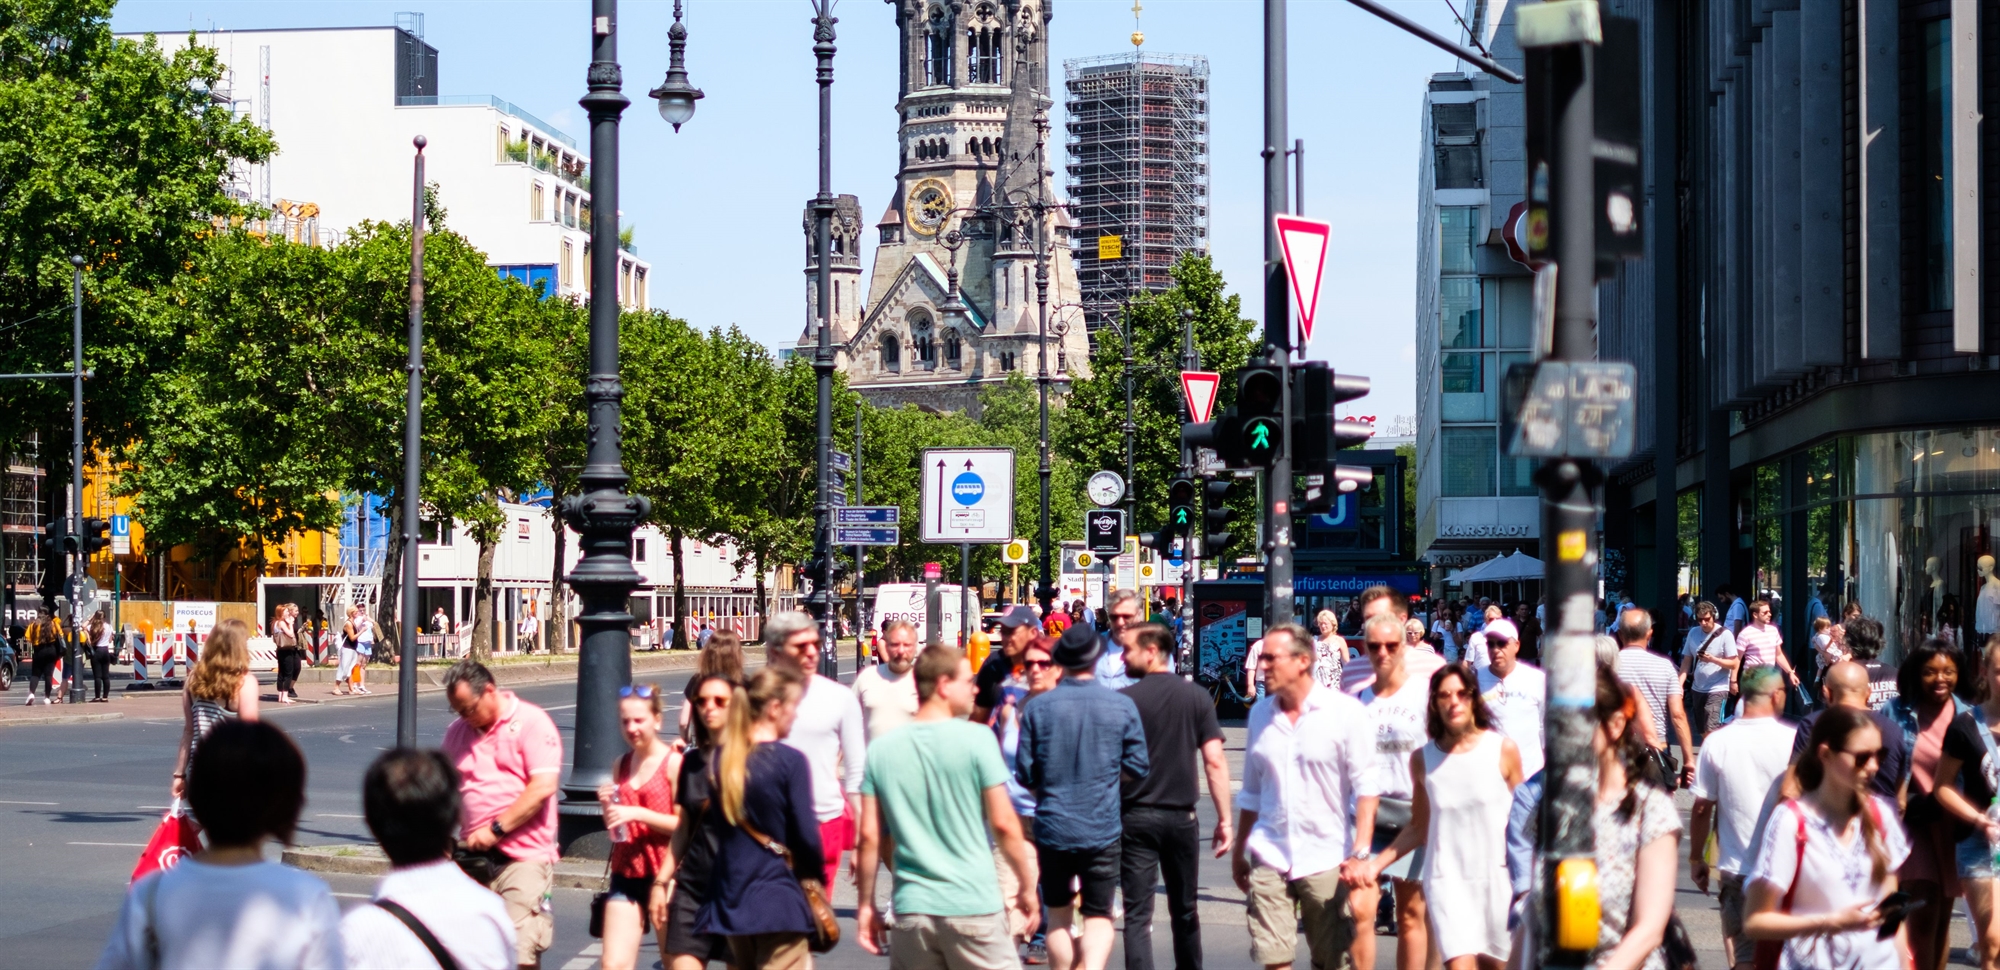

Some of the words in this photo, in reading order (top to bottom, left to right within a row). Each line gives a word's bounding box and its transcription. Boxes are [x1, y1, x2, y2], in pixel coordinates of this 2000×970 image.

[117, 517, 127, 534] U
[1441, 524, 1529, 537] KARSTADT
[1434, 554, 1496, 565] KARSTA
[1293, 577, 1387, 590] urfürstendamm
[884, 612, 952, 622] PROSER
